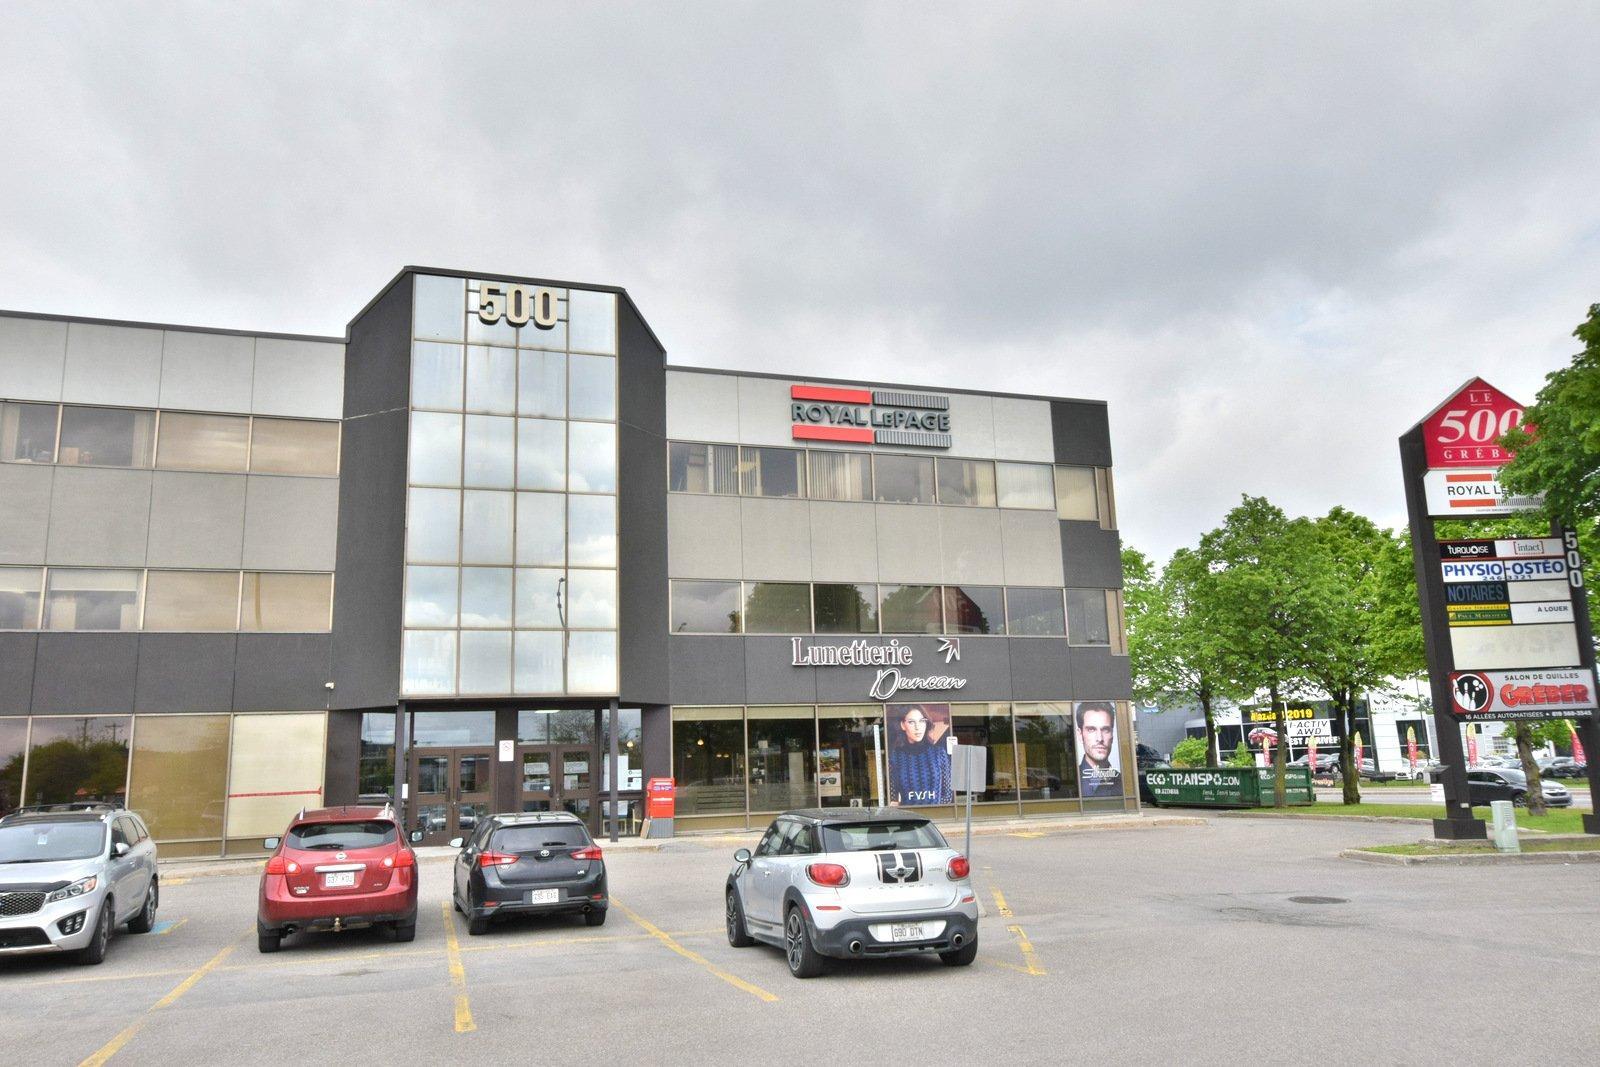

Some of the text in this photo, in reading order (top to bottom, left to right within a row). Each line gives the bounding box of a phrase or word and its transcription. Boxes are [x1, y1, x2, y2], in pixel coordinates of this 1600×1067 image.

[479, 282, 558, 329] 500
[1469, 392, 1493, 403] LE
[791, 403, 868, 427] ROYAL
[1443, 447, 1516, 460] GRÉBE
[1447, 485, 1490, 495] ROYAL
[1447, 584, 1505, 601] NOTAIRES
[791, 637, 913, 666] Lunetterie
[1546, 672, 1580, 680] QUILLES
[869, 668, 967, 700] Duncan
[1287, 708, 1314, 719] 2019
[1297, 728, 1322, 736] AWD
